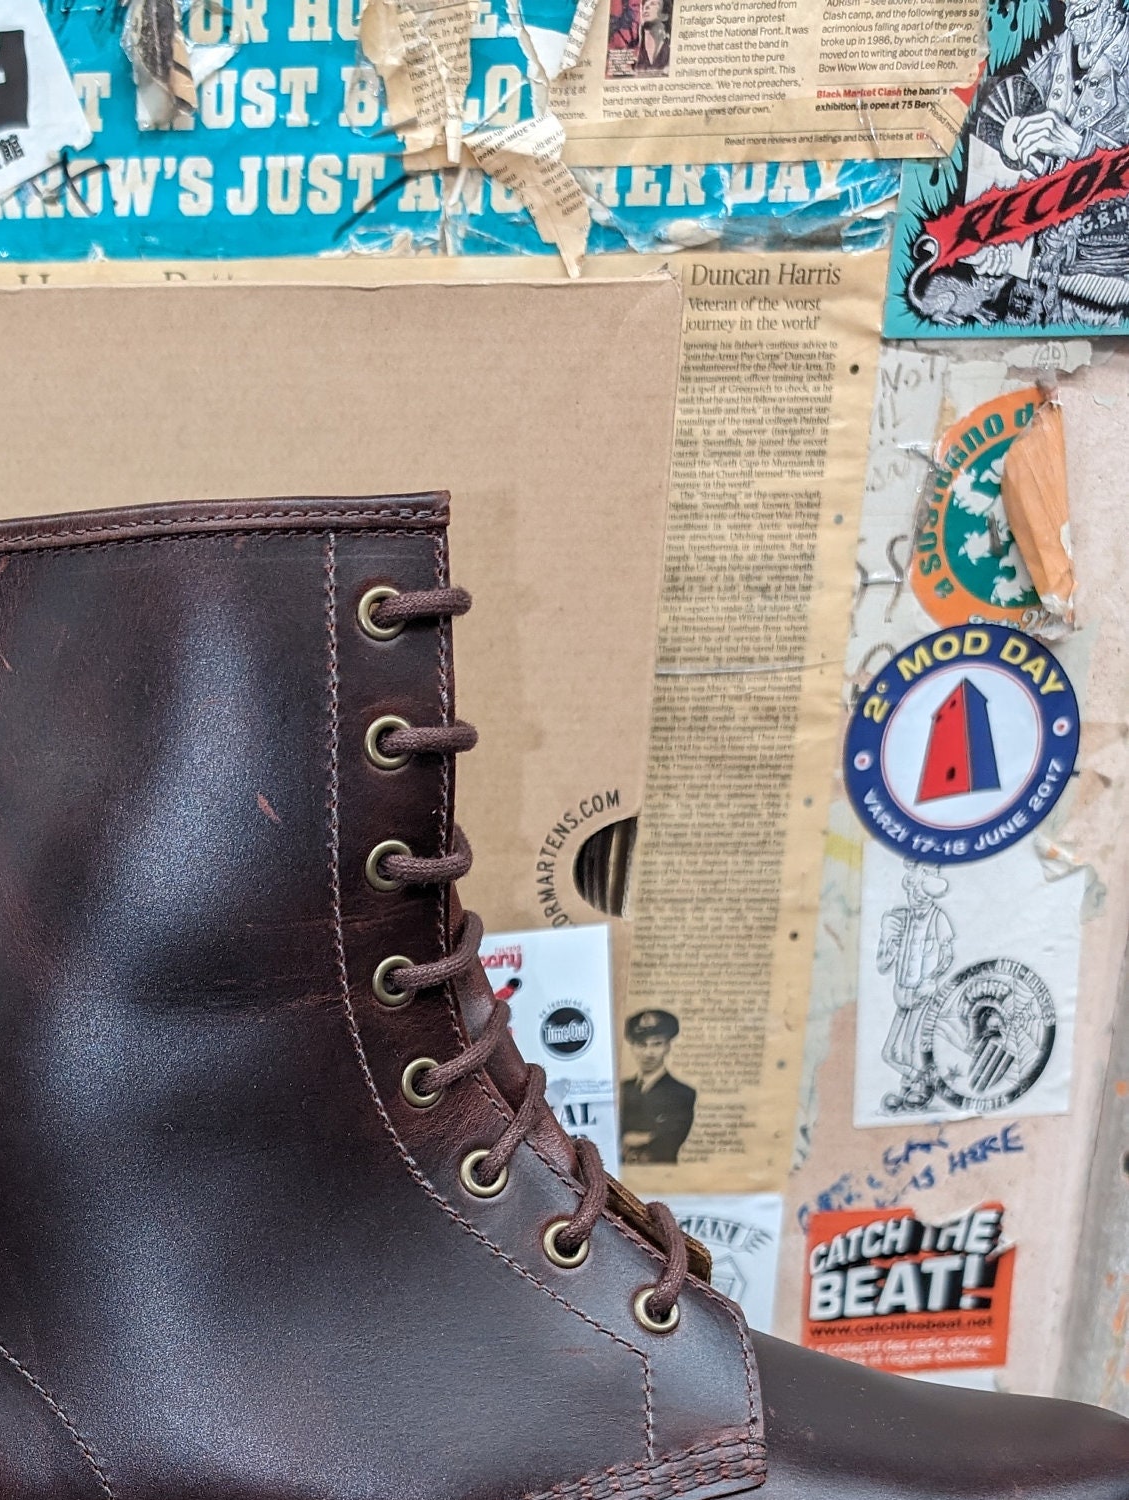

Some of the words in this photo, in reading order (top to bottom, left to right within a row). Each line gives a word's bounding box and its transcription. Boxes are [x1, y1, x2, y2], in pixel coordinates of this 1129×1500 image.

[680, 3, 713, 13] punkers
[740, 1, 776, 10] marched
[778, 1, 797, 9] from
[679, 17, 714, 25] Trafalgar
[716, 16, 745, 25] Square
[755, 15, 785, 24] protest
[678, 30, 708, 40] against
[710, 29, 722, 38] the
[724, 28, 757, 37] National
[760, 27, 783, 36] Front.
[785, 27, 791, 35] It
[792, 27, 809, 35] was
[683, 43, 705, 51] move
[708, 42, 723, 50] that
[743, 41, 757, 49] the
[758, 40, 779, 48] band
[781, 40, 788, 48] in
[821, 38, 844, 46] broke
[846, 39, 857, 47] up
[868, 36, 892, 45] 1986,
[894, 36, 903, 45] by
[905, 35, 928, 44] which
[952, 35, 972, 43] Time
[676, 56, 696, 64] clear
[698, 54, 740, 65] opposition
[742, 54, 750, 62] to
[752, 53, 764, 62] the
[766, 54, 785, 63] pure
[820, 51, 848, 59] moved
[871, 50, 897, 59] writing
[899, 49, 923, 57] about
[925, 48, 938, 56] the
[958, 48, 970, 58] big
[676, 68, 707, 77] nihilism
[709, 68, 716, 76] of
[718, 67, 730, 75] the
[732, 67, 753, 75] punk
[779, 65, 796, 74] This
[819, 64, 837, 72] Bow
[838, 63, 857, 71] Wow
[859, 62, 877, 71] Wow
[879, 62, 894, 70] and
[896, 61, 919, 70] David
[921, 61, 936, 69] Lee
[938, 61, 958, 69] Roth.
[843, 89, 876, 98] Market
[878, 88, 902, 96] Clash
[903, 88, 918, 96] the
[920, 86, 947, 95] band's
[815, 102, 859, 111] exhibition,
[861, 102, 868, 110] is
[870, 102, 889, 111] open
[902, 101, 912, 109] 75
[227, 155, 385, 215] JUST
[691, 264, 770, 286] Duncan
[778, 262, 841, 286] Harris
[688, 297, 737, 312] Veteran
[741, 297, 756, 311] of
[758, 296, 778, 311] the
[683, 318, 734, 333] journey
[740, 318, 752, 330] in
[757, 317, 778, 330] the
[896, 630, 990, 682] MOD
[999, 636, 1065, 695] DAY
[863, 788, 909, 842] VARZI
[912, 832, 968, 855] 17-18
[974, 809, 1030, 850] JUNE
[1028, 757, 1063, 812] 2017
[809, 1216, 916, 1276] CATCH
[808, 1253, 988, 1322] BEAT!
